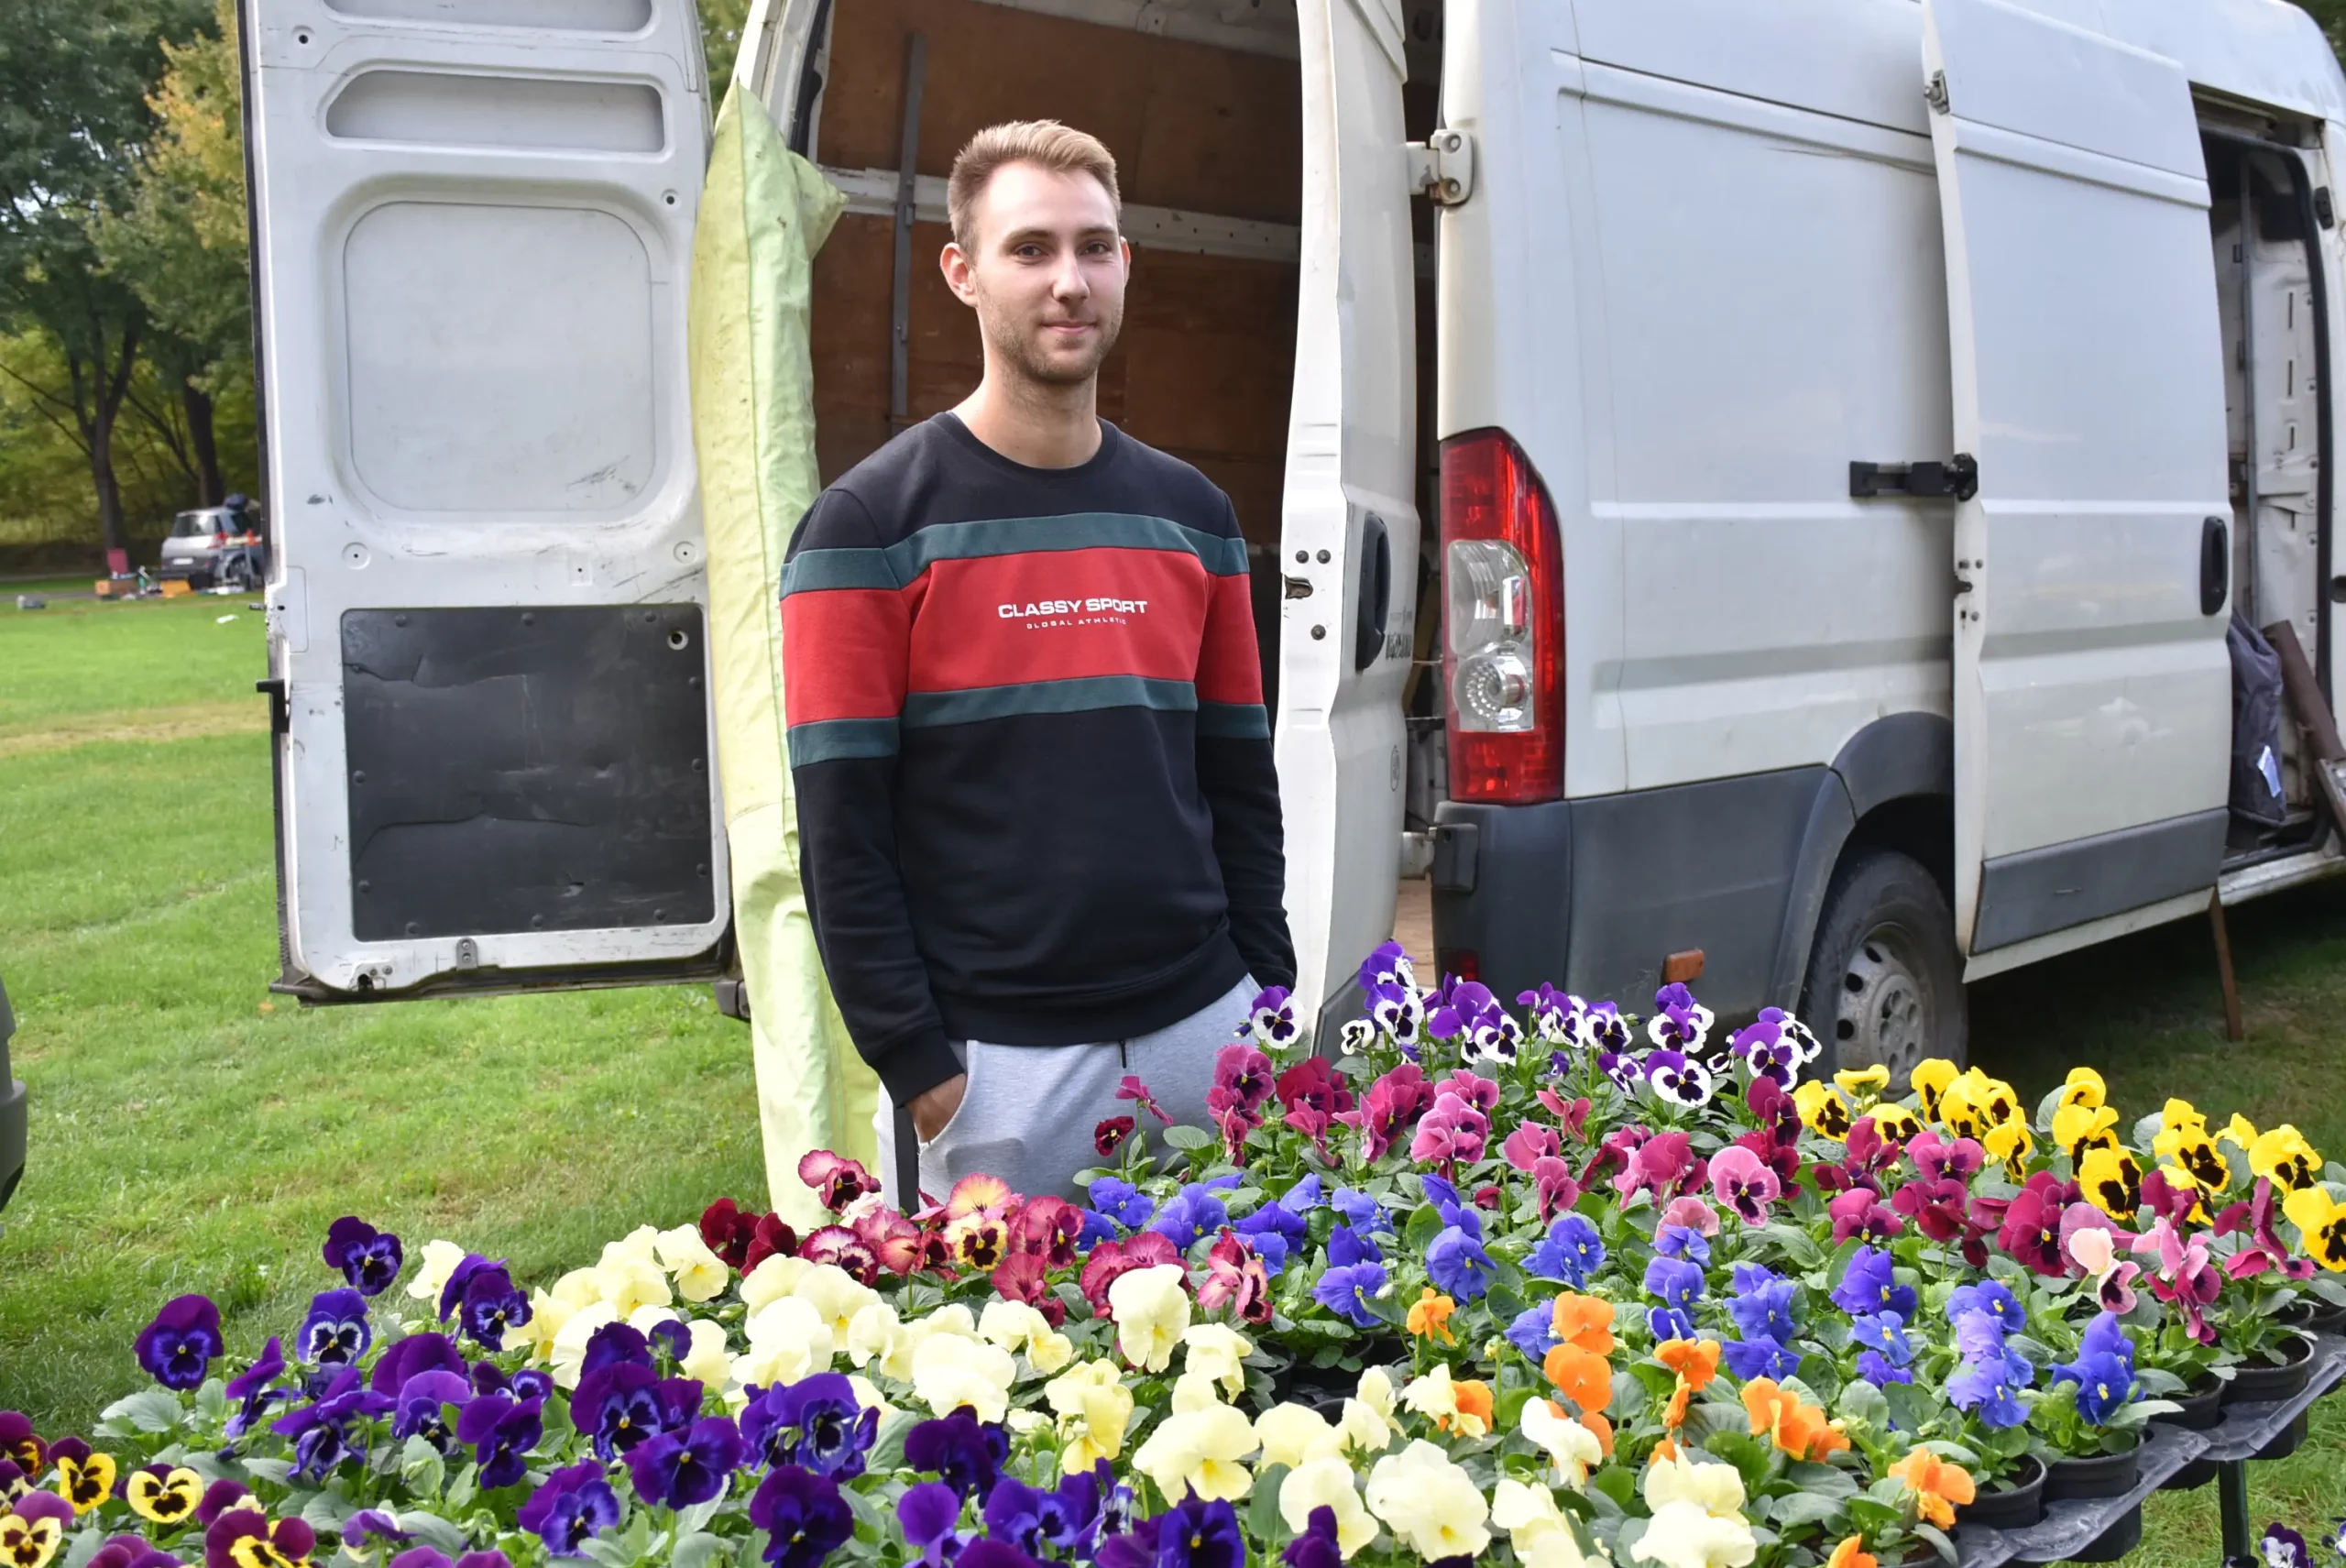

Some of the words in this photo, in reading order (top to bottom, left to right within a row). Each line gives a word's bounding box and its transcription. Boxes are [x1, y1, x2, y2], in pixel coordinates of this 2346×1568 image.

[998, 600, 1081, 618] CLASSY
[1085, 598, 1147, 613] SPORT
[1026, 620, 1072, 630] GLOBAL
[1078, 617, 1126, 625] ATHLETIC
